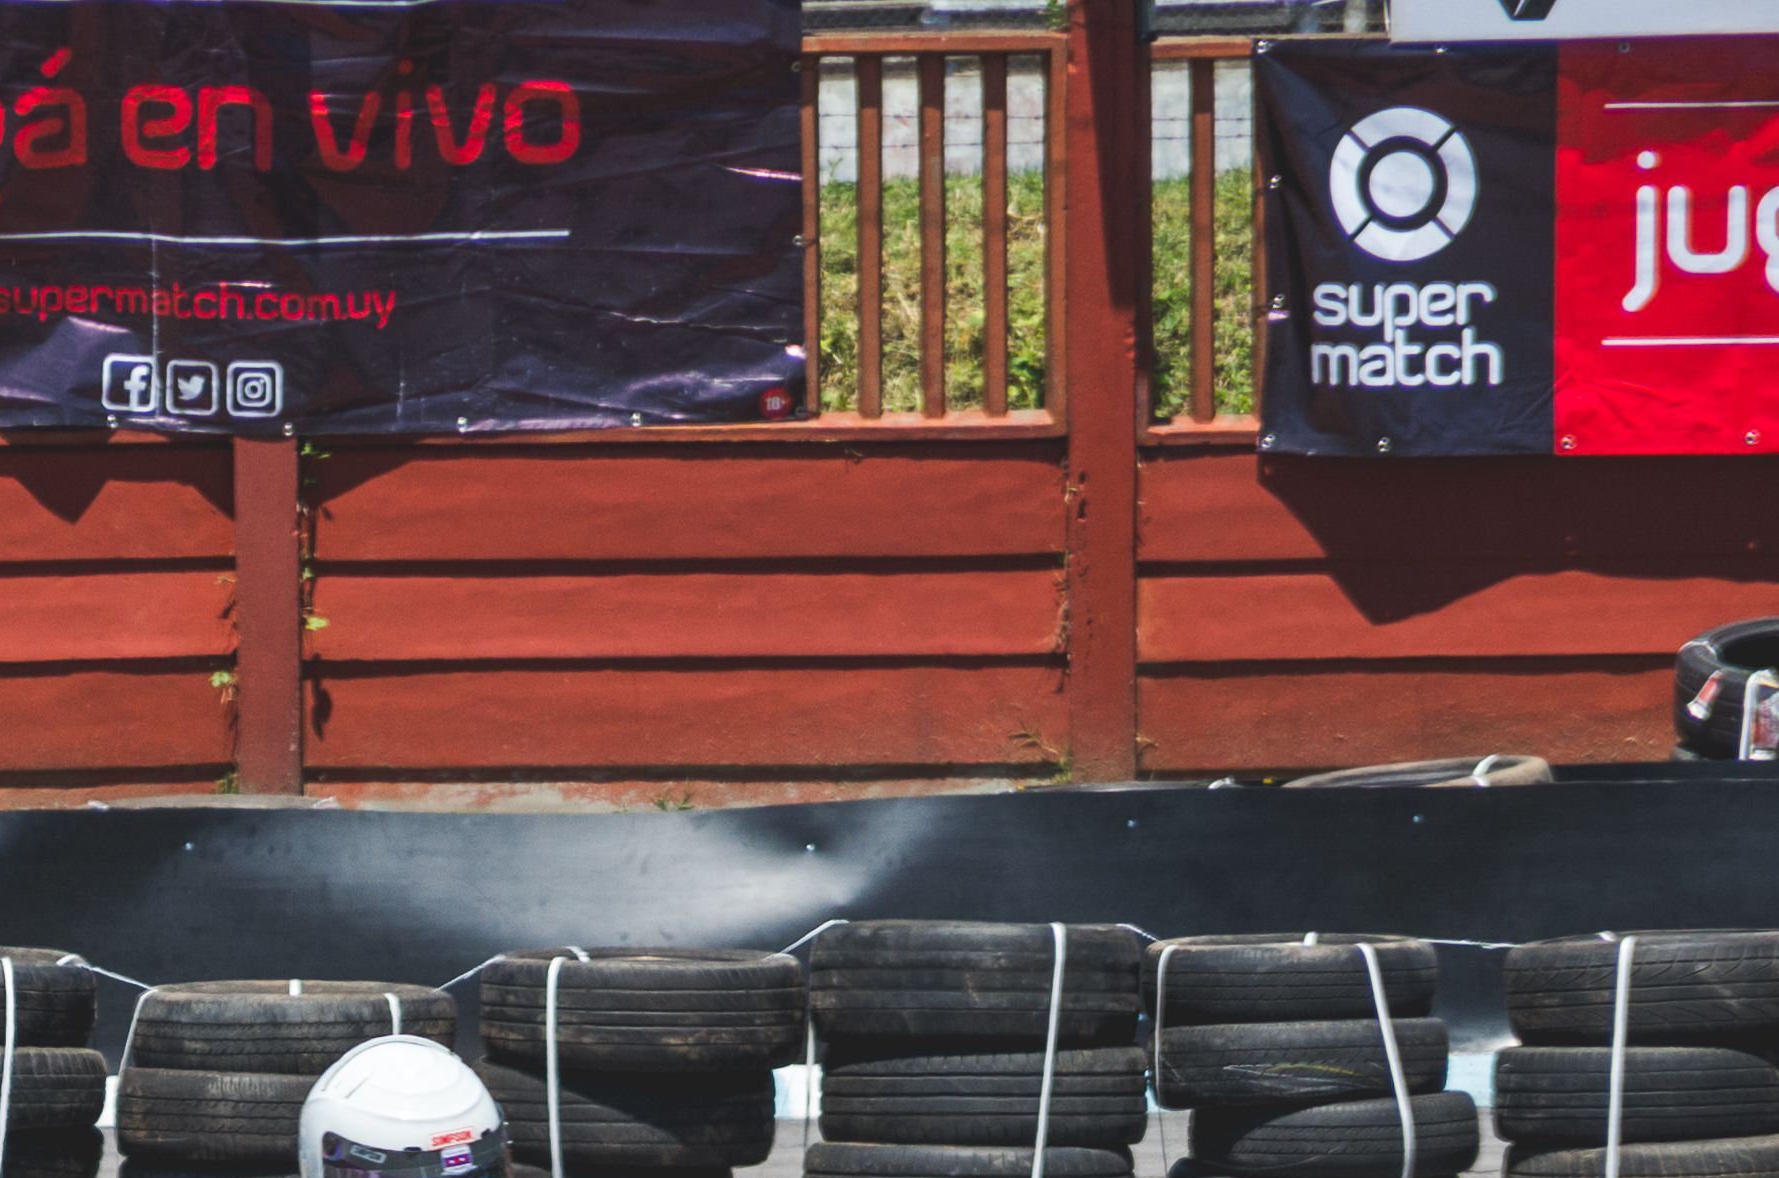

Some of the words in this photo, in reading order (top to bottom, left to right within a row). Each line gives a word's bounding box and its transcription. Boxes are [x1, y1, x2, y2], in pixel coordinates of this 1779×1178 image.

[120, 83, 274, 171] en
[310, 58, 581, 171] vivo
[1622, 150, 1779, 313] ju
[1312, 281, 1498, 342] super
[1310, 326, 1504, 386] match
